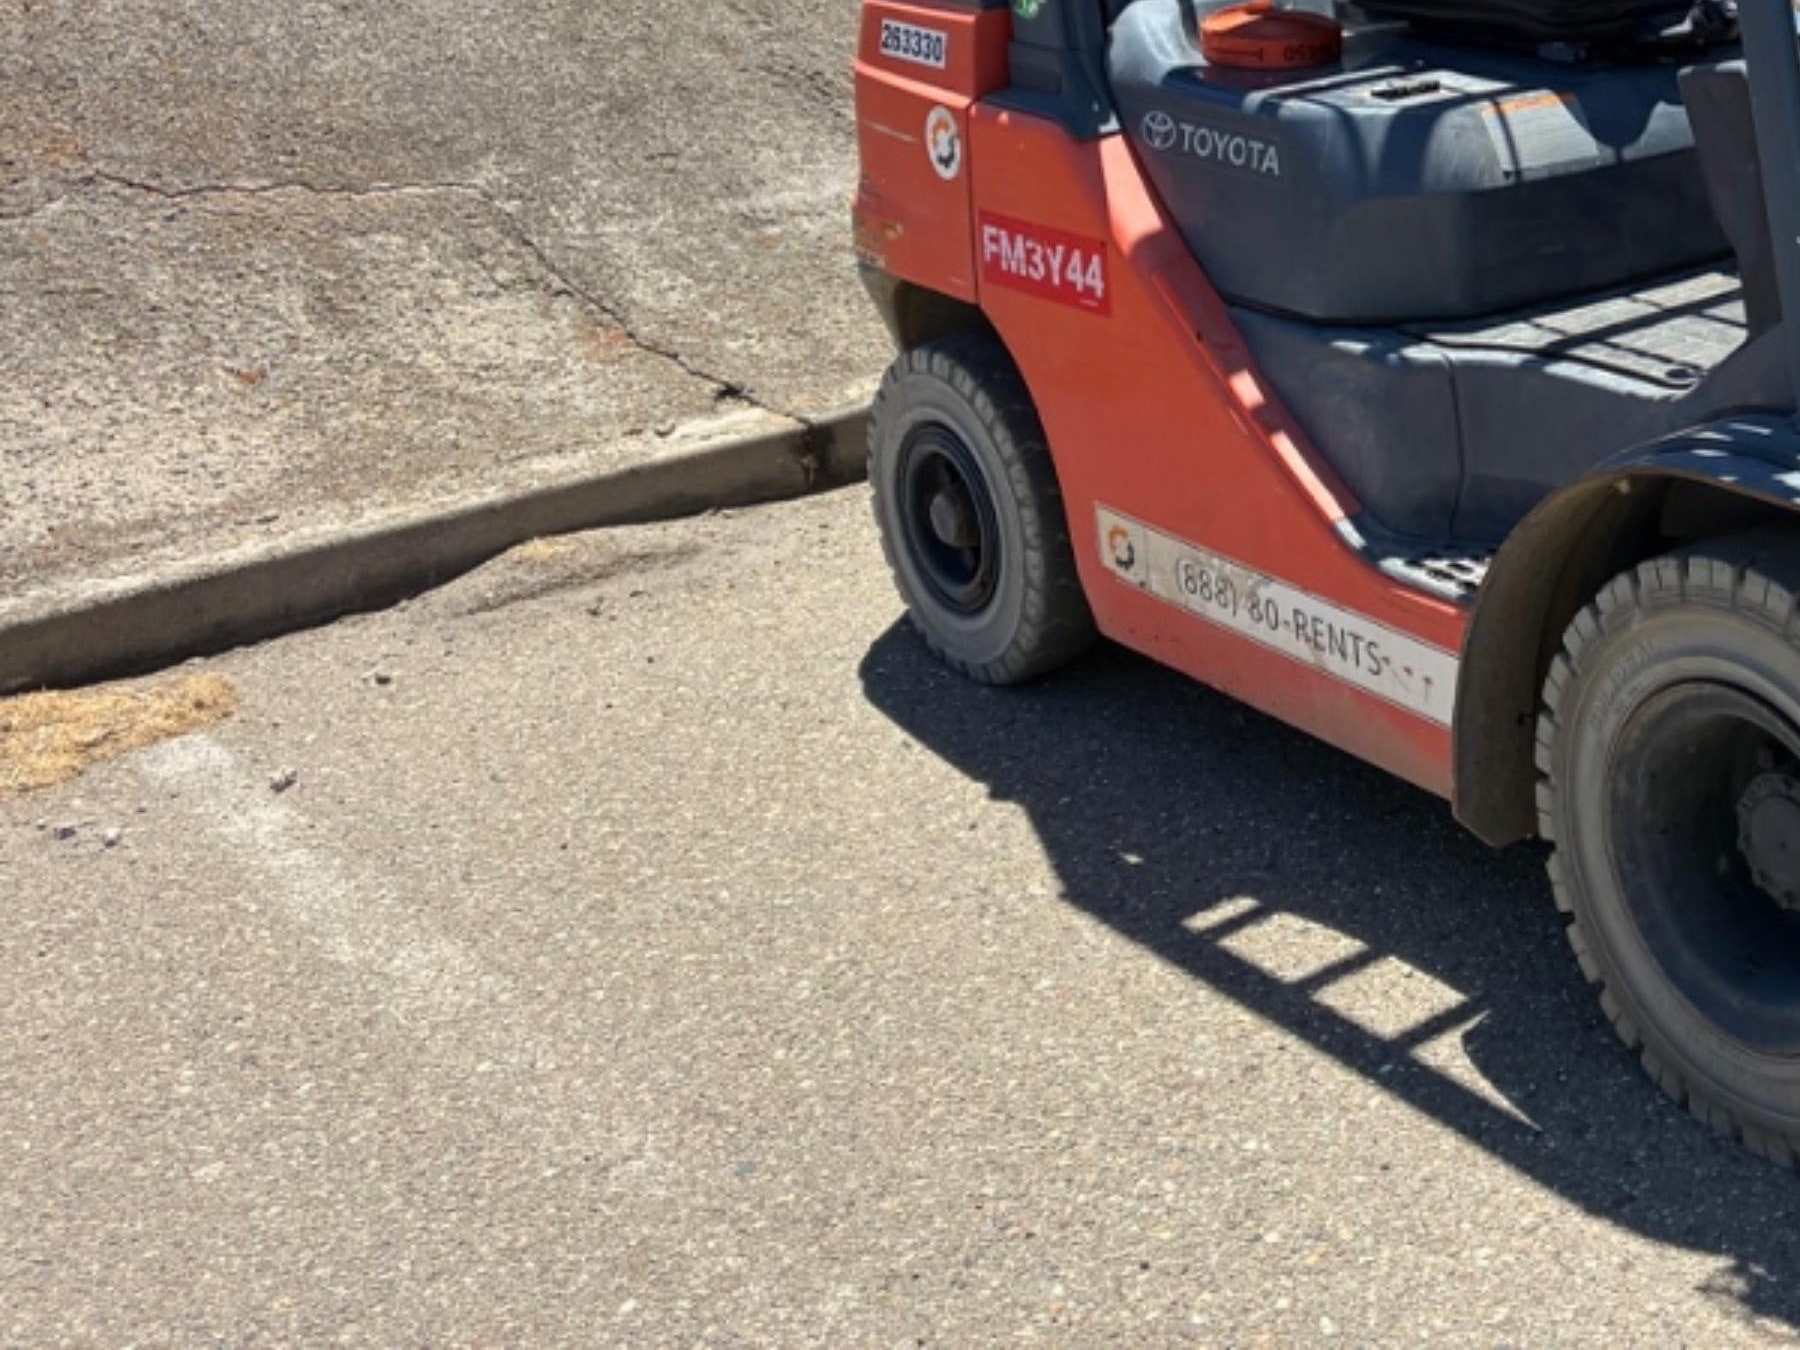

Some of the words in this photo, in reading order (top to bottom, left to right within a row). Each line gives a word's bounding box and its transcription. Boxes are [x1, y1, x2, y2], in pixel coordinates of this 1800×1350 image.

[881, 23, 944, 63] 263330
[1178, 122, 1281, 176] TOYOTA
[982, 224, 1105, 299] FM3Y44
